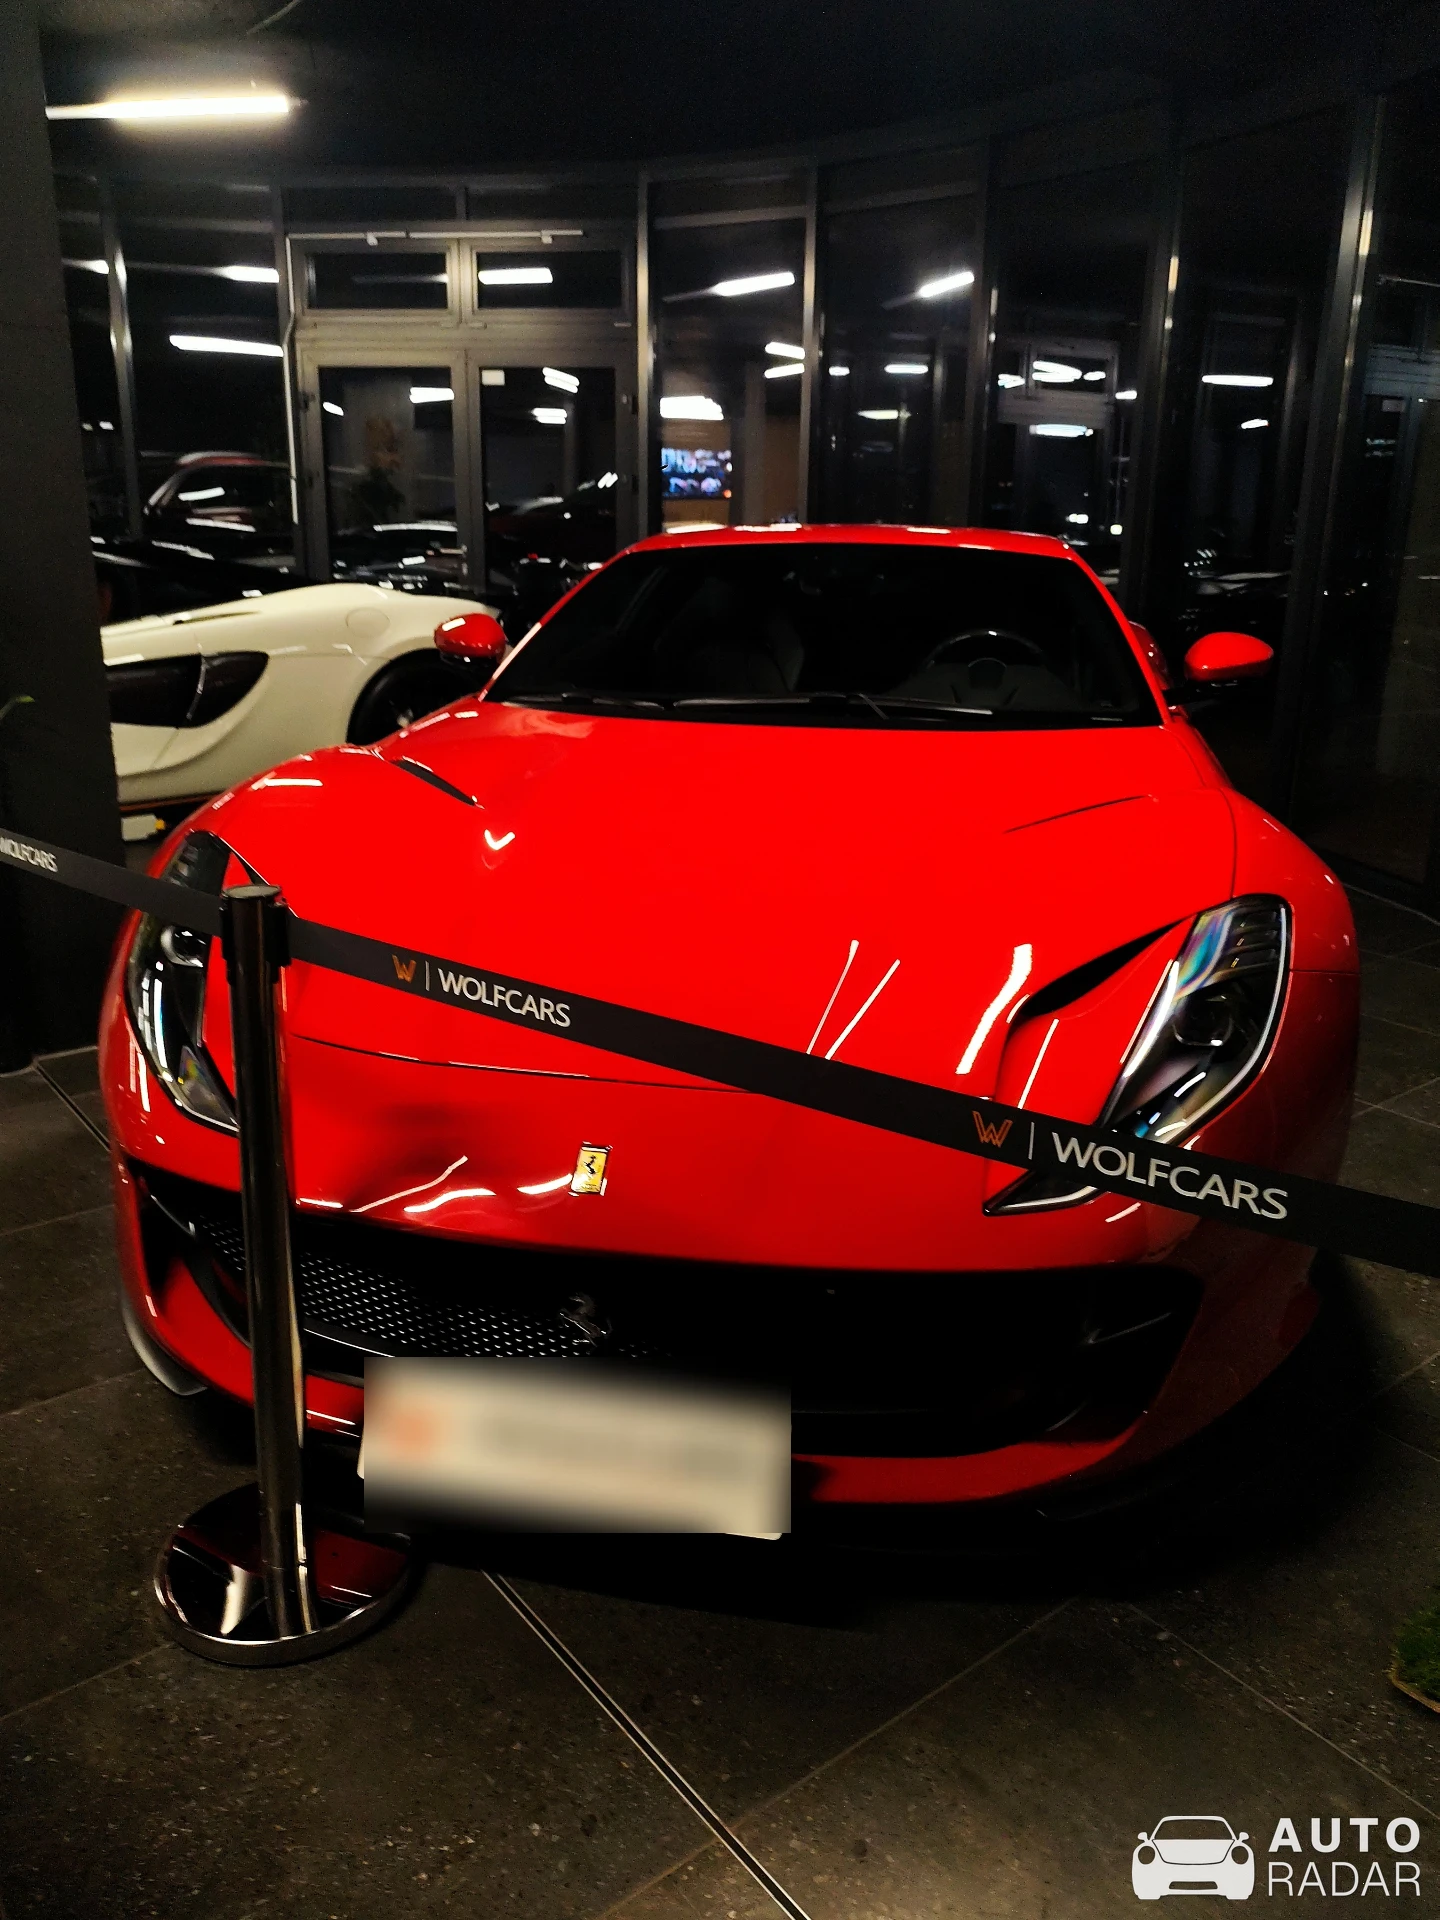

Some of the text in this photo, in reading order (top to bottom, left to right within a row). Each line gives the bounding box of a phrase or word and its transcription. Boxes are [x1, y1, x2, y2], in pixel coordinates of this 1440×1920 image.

[391, 954, 572, 1028] W WOLFCARS
[972, 1110, 1289, 1220] W WOLFCARS
